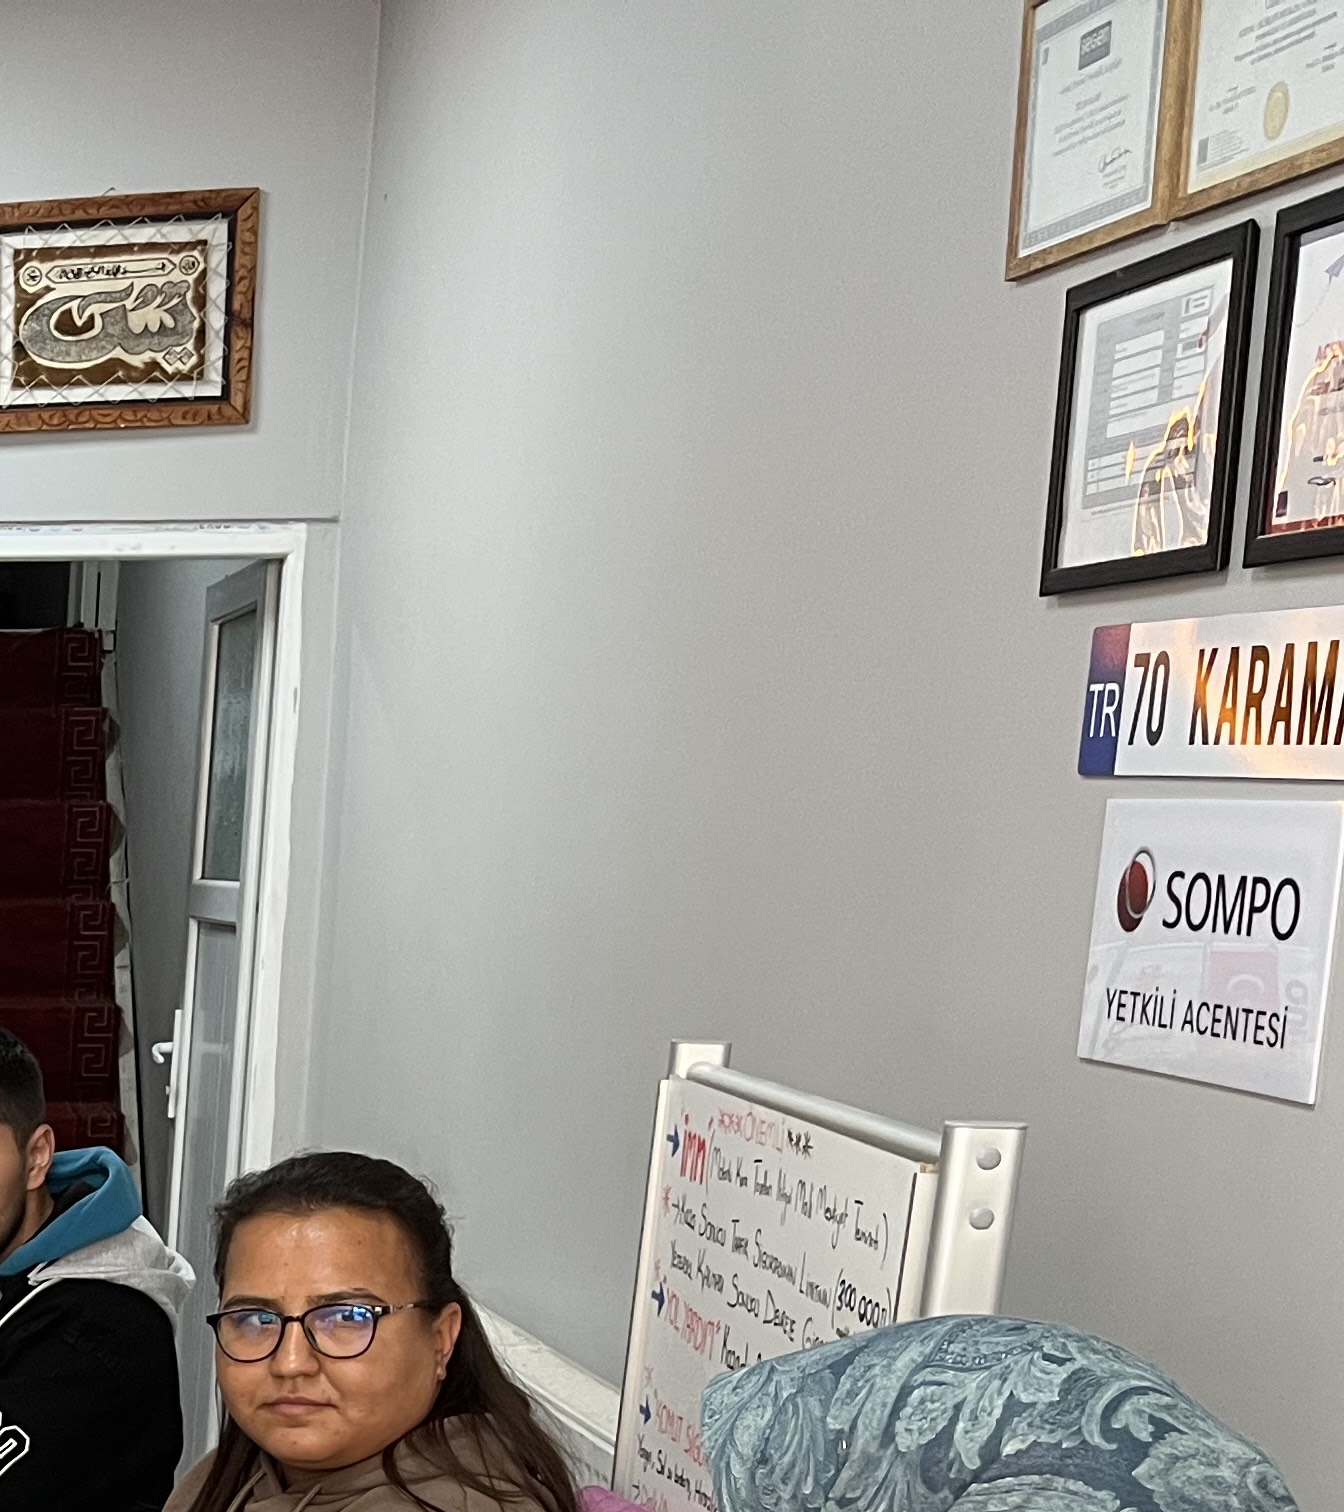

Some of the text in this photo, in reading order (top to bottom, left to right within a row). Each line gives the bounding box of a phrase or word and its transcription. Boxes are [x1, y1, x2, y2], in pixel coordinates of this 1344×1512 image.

[1089, 639, 1344, 746] TR 70 KARAM
[1162, 870, 1301, 942] SOMPO
[1106, 986, 1177, 1030] YETKİLİ
[1181, 1000, 1289, 1049] ACENTESİ
